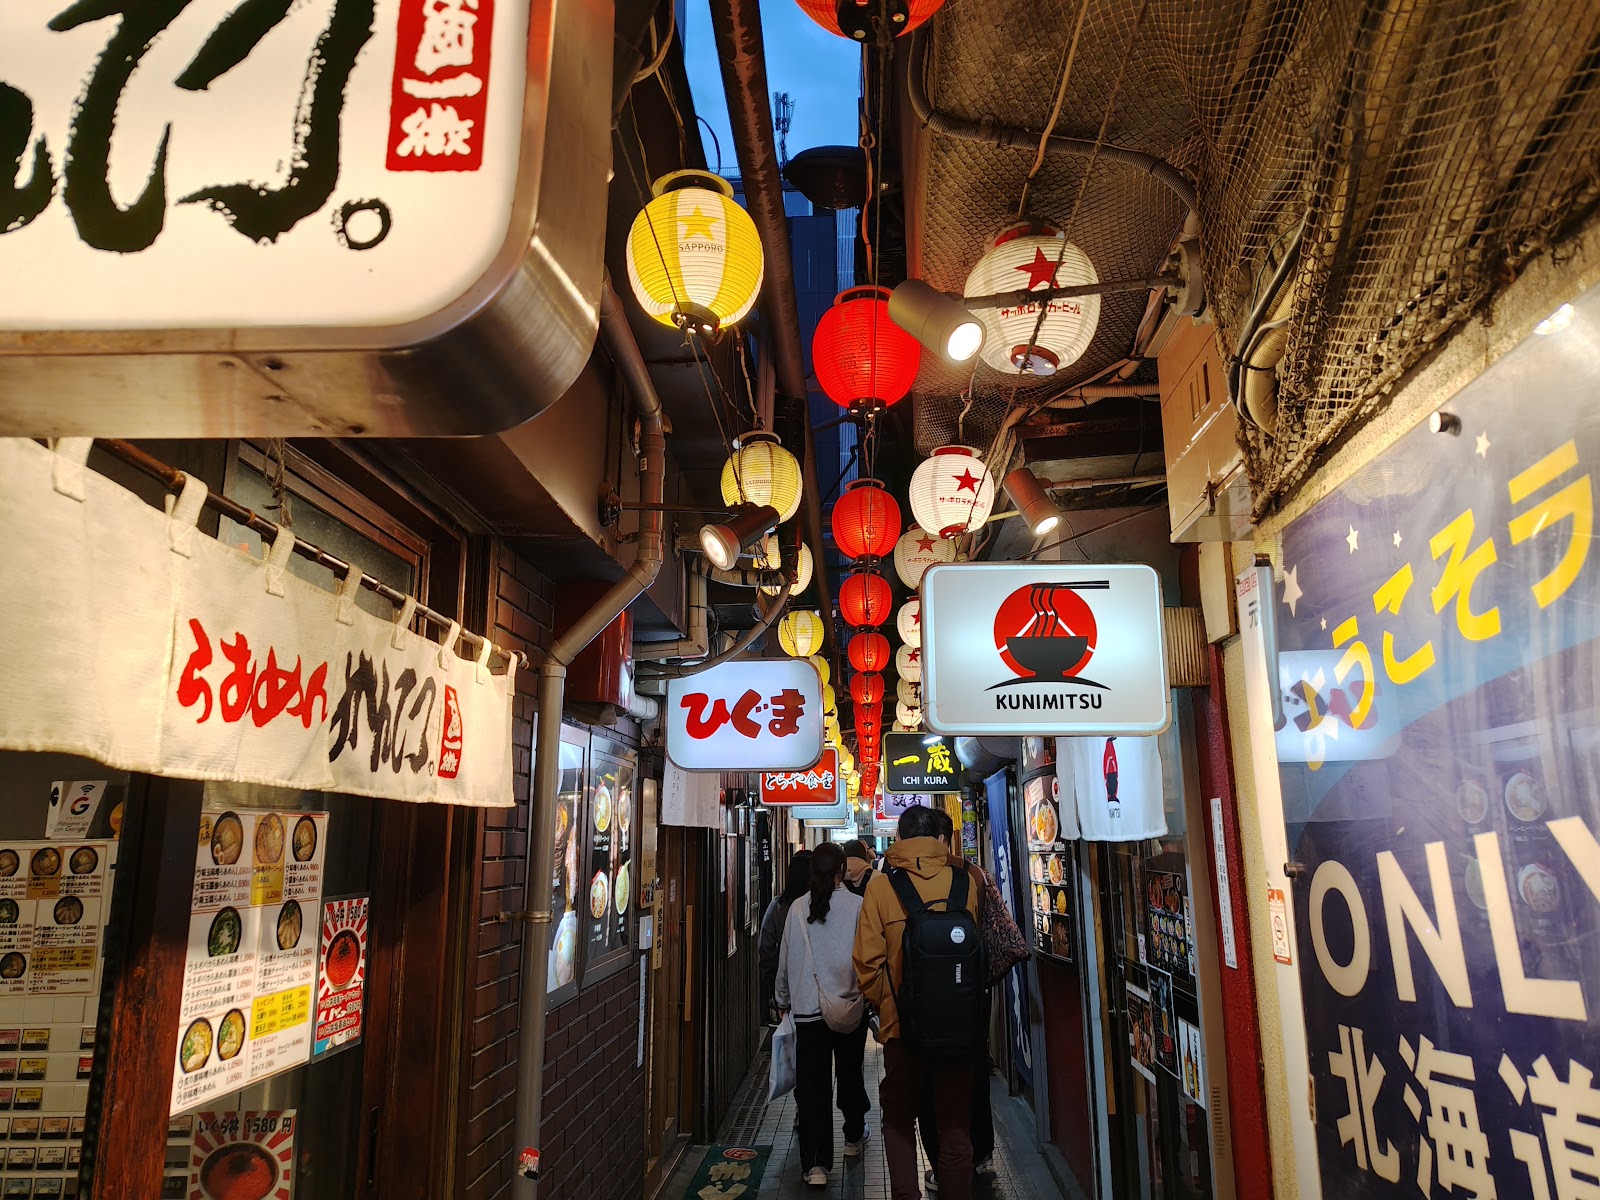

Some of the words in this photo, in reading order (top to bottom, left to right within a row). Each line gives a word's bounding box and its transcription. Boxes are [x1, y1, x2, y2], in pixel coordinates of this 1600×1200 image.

[678, 243, 724, 253] SAPPORO
[996, 693, 1103, 711] KUNIMITSU
[680, 688, 806, 740] ひぐま
[893, 743, 953, 774] 一蔵
[764, 769, 834, 791] とらや食堂
[902, 776, 920, 785] ICHI
[924, 776, 948, 785] KURA
[198, 1118, 239, 1134] いくら丼
[246, 1117, 277, 1134] 1580
[281, 1117, 292, 1133] 円
